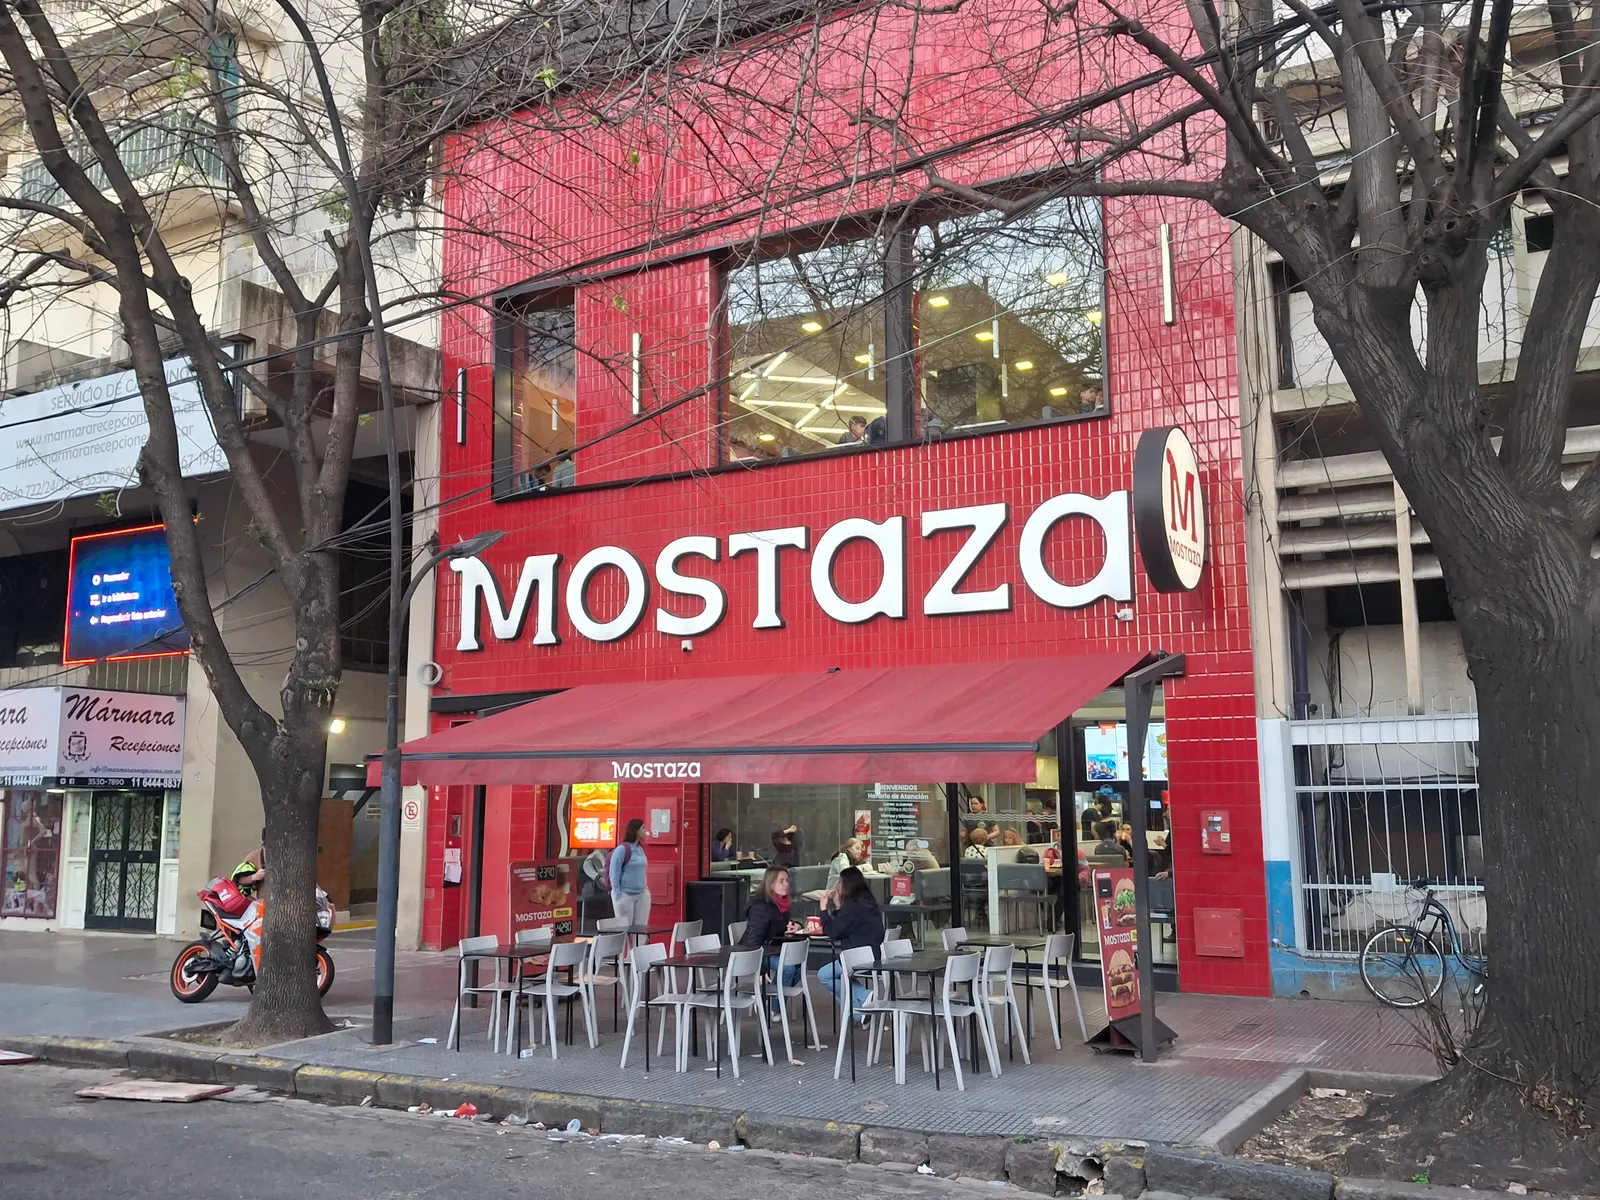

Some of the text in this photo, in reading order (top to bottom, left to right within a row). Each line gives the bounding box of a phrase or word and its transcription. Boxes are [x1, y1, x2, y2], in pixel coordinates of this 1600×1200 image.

[51, 386, 103, 410] SERVICIO
[106, 382, 122, 398] DE
[1166, 447, 1198, 543] M
[65, 693, 176, 726] Mármara
[108, 736, 181, 756] Recepciones
[131, 778, 182, 789] 11 6444-8837
